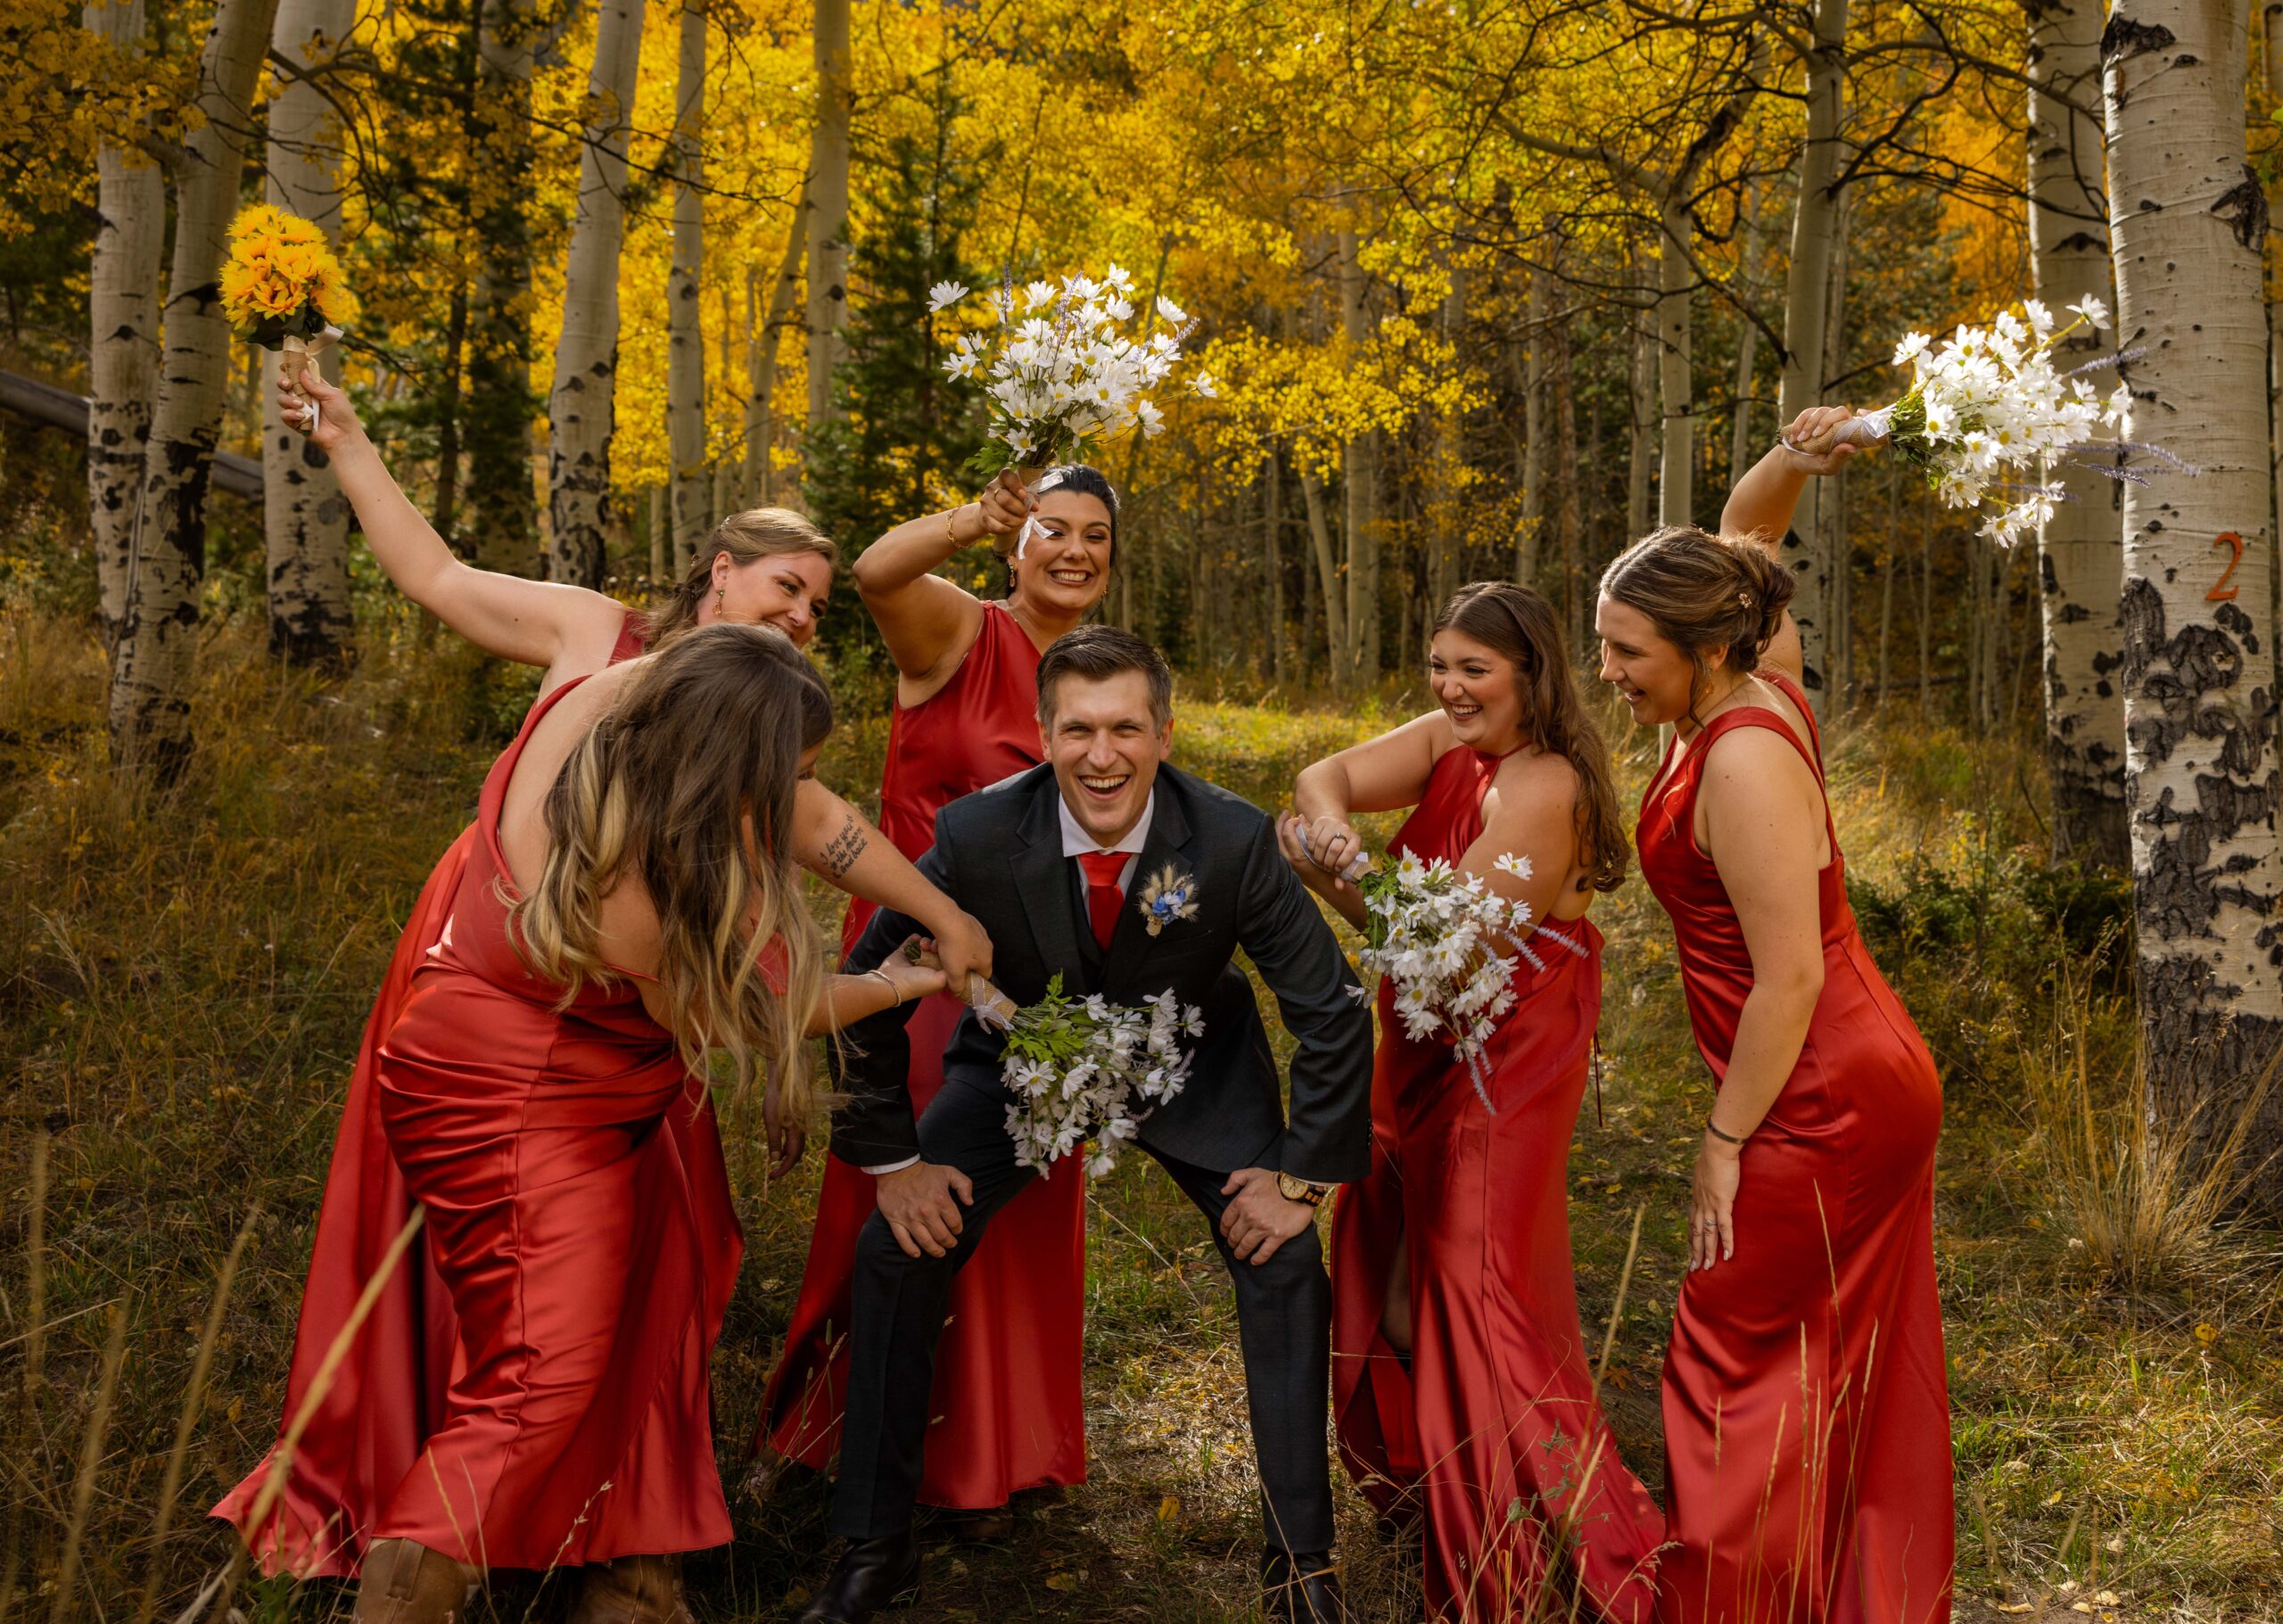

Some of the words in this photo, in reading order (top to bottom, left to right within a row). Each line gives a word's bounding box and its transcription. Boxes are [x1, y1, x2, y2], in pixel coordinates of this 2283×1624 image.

[2205, 532, 2244, 600] 2
[826, 837, 842, 856] love
[836, 850, 847, 863] the
[851, 837, 869, 859] back
